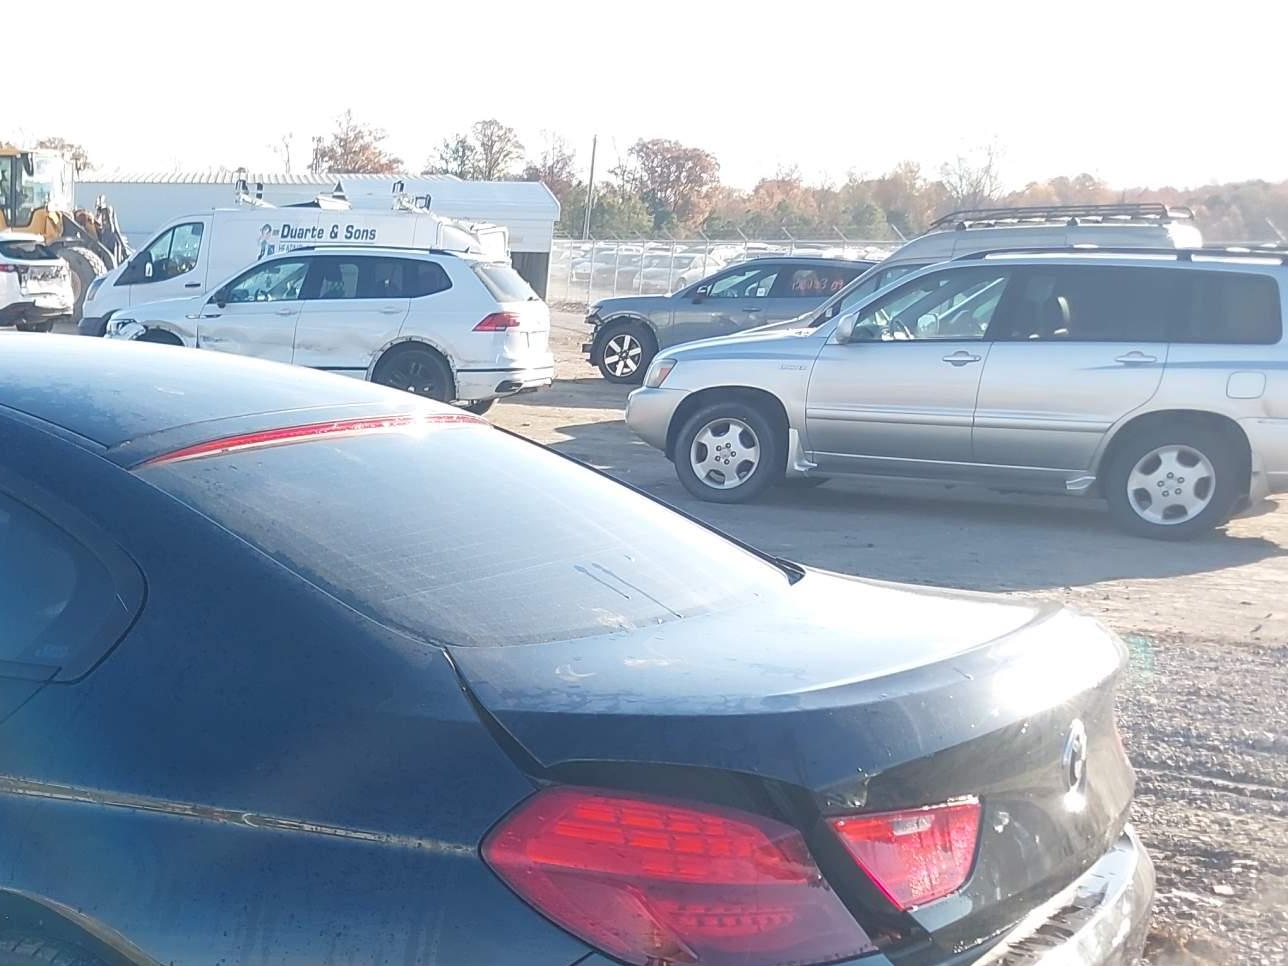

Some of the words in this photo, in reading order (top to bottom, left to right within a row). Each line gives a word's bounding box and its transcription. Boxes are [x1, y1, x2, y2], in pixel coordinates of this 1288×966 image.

[280, 223, 324, 240] Duarte
[329, 223, 339, 240] &
[344, 224, 376, 241] Sons
